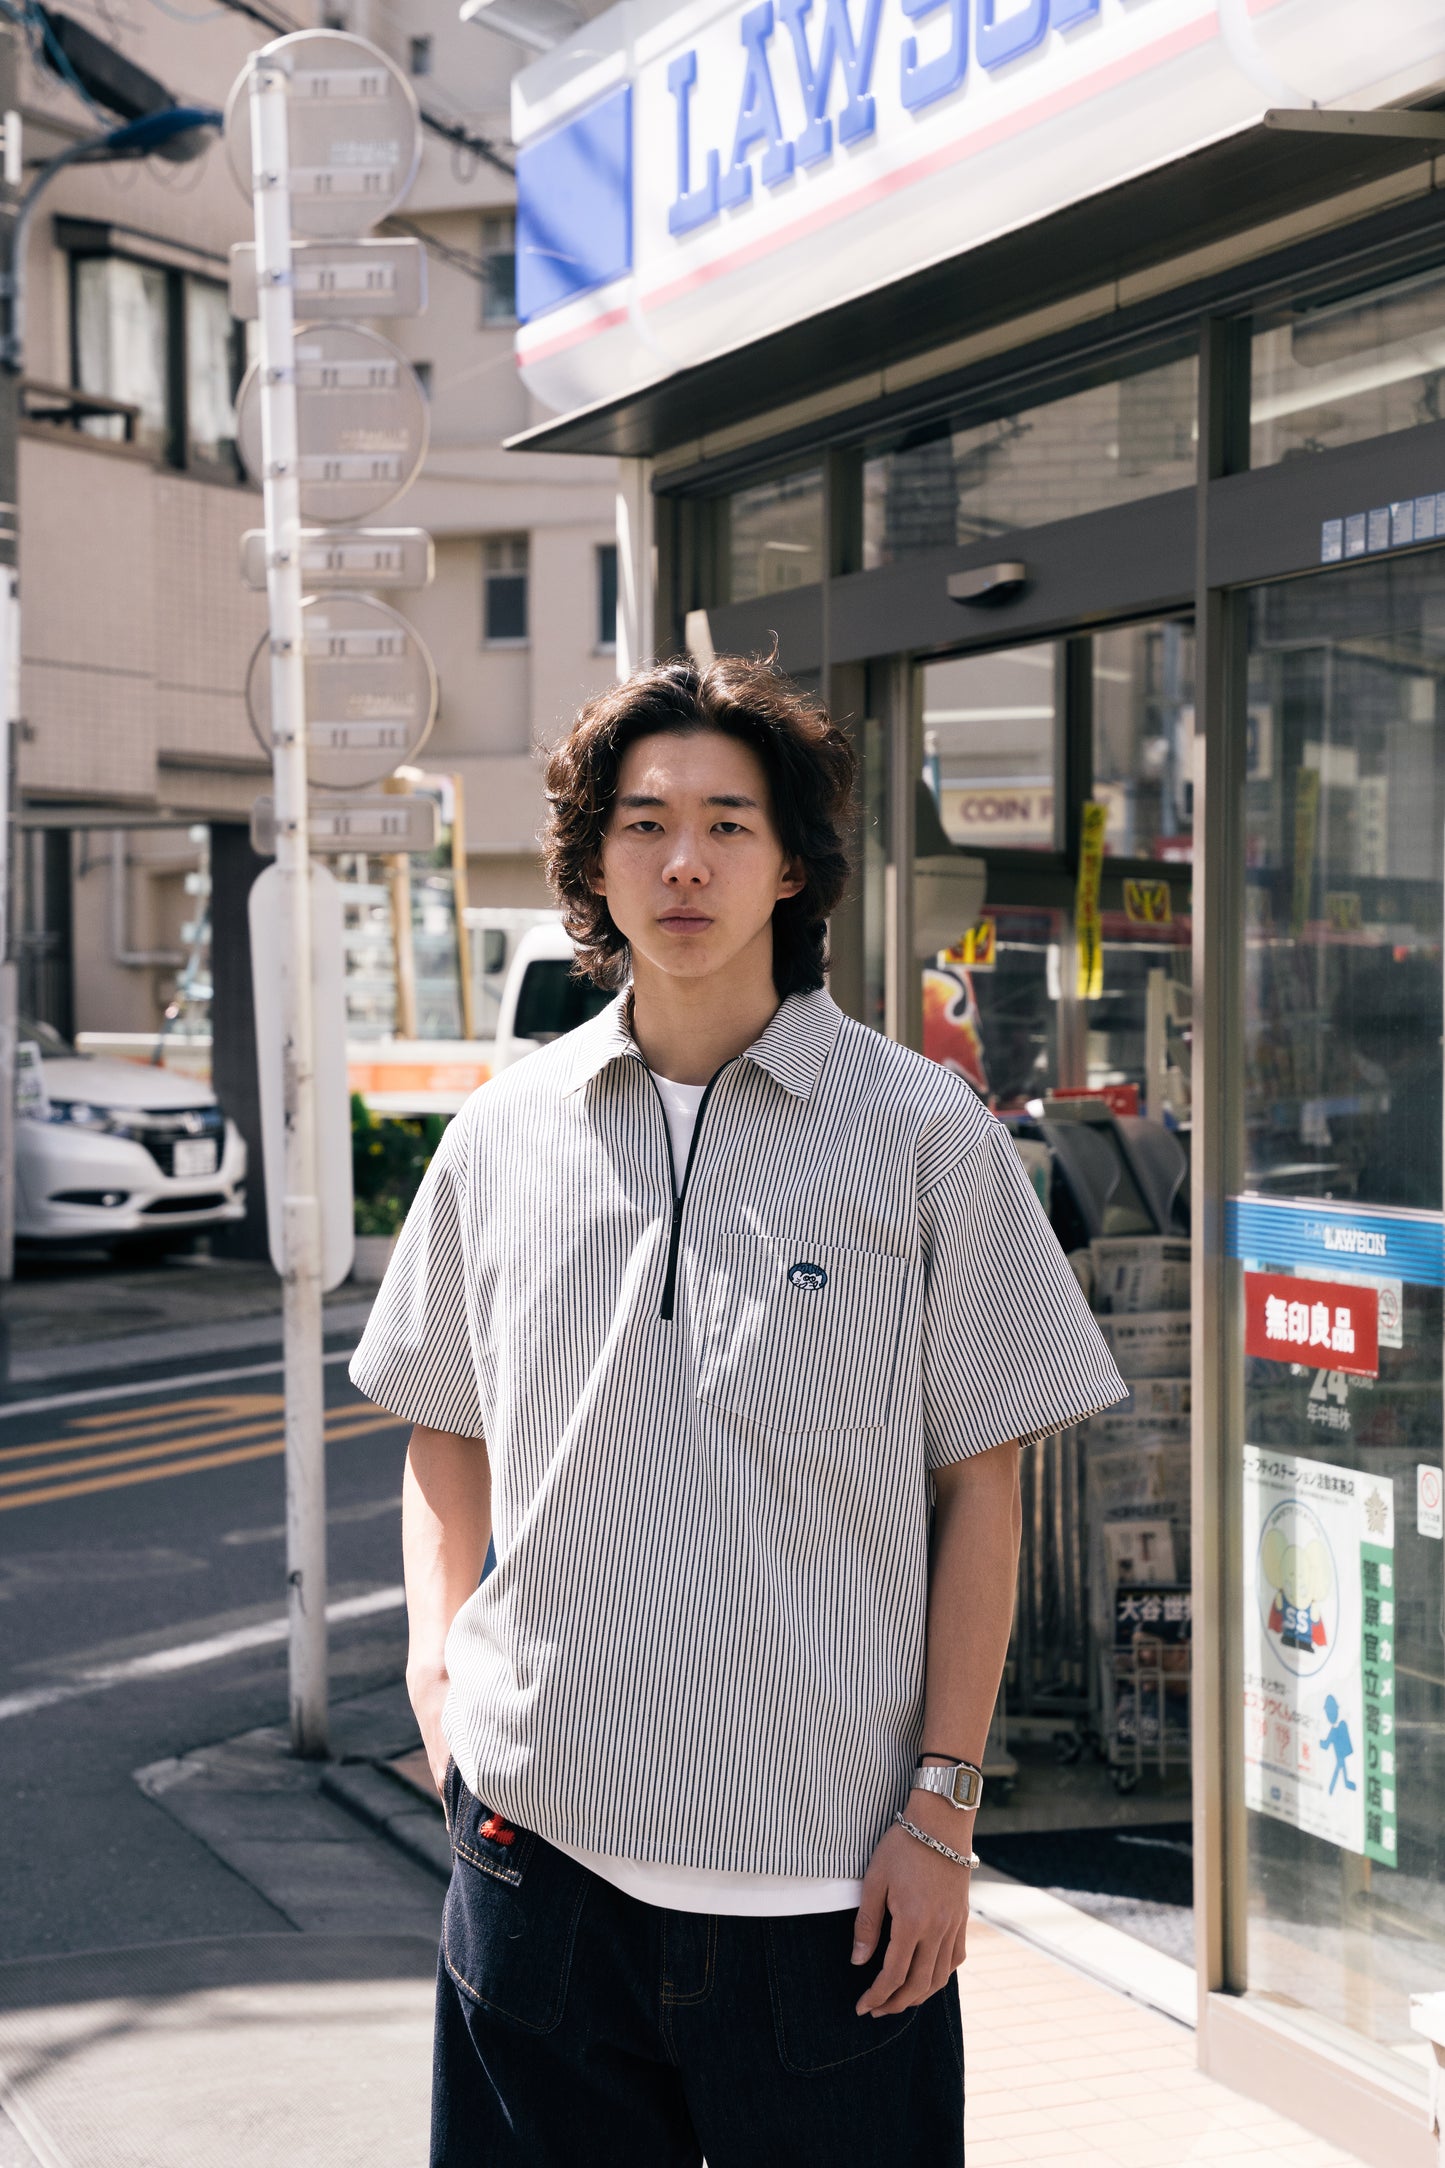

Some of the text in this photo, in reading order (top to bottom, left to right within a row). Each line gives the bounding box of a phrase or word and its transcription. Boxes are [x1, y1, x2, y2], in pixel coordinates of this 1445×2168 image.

[667, 0, 1101, 237] LAWS
[961, 797, 1030, 824] COIN
[1264, 1294, 1355, 1353] 無印良品
[1307, 1402, 1352, 1432] 年中無休
